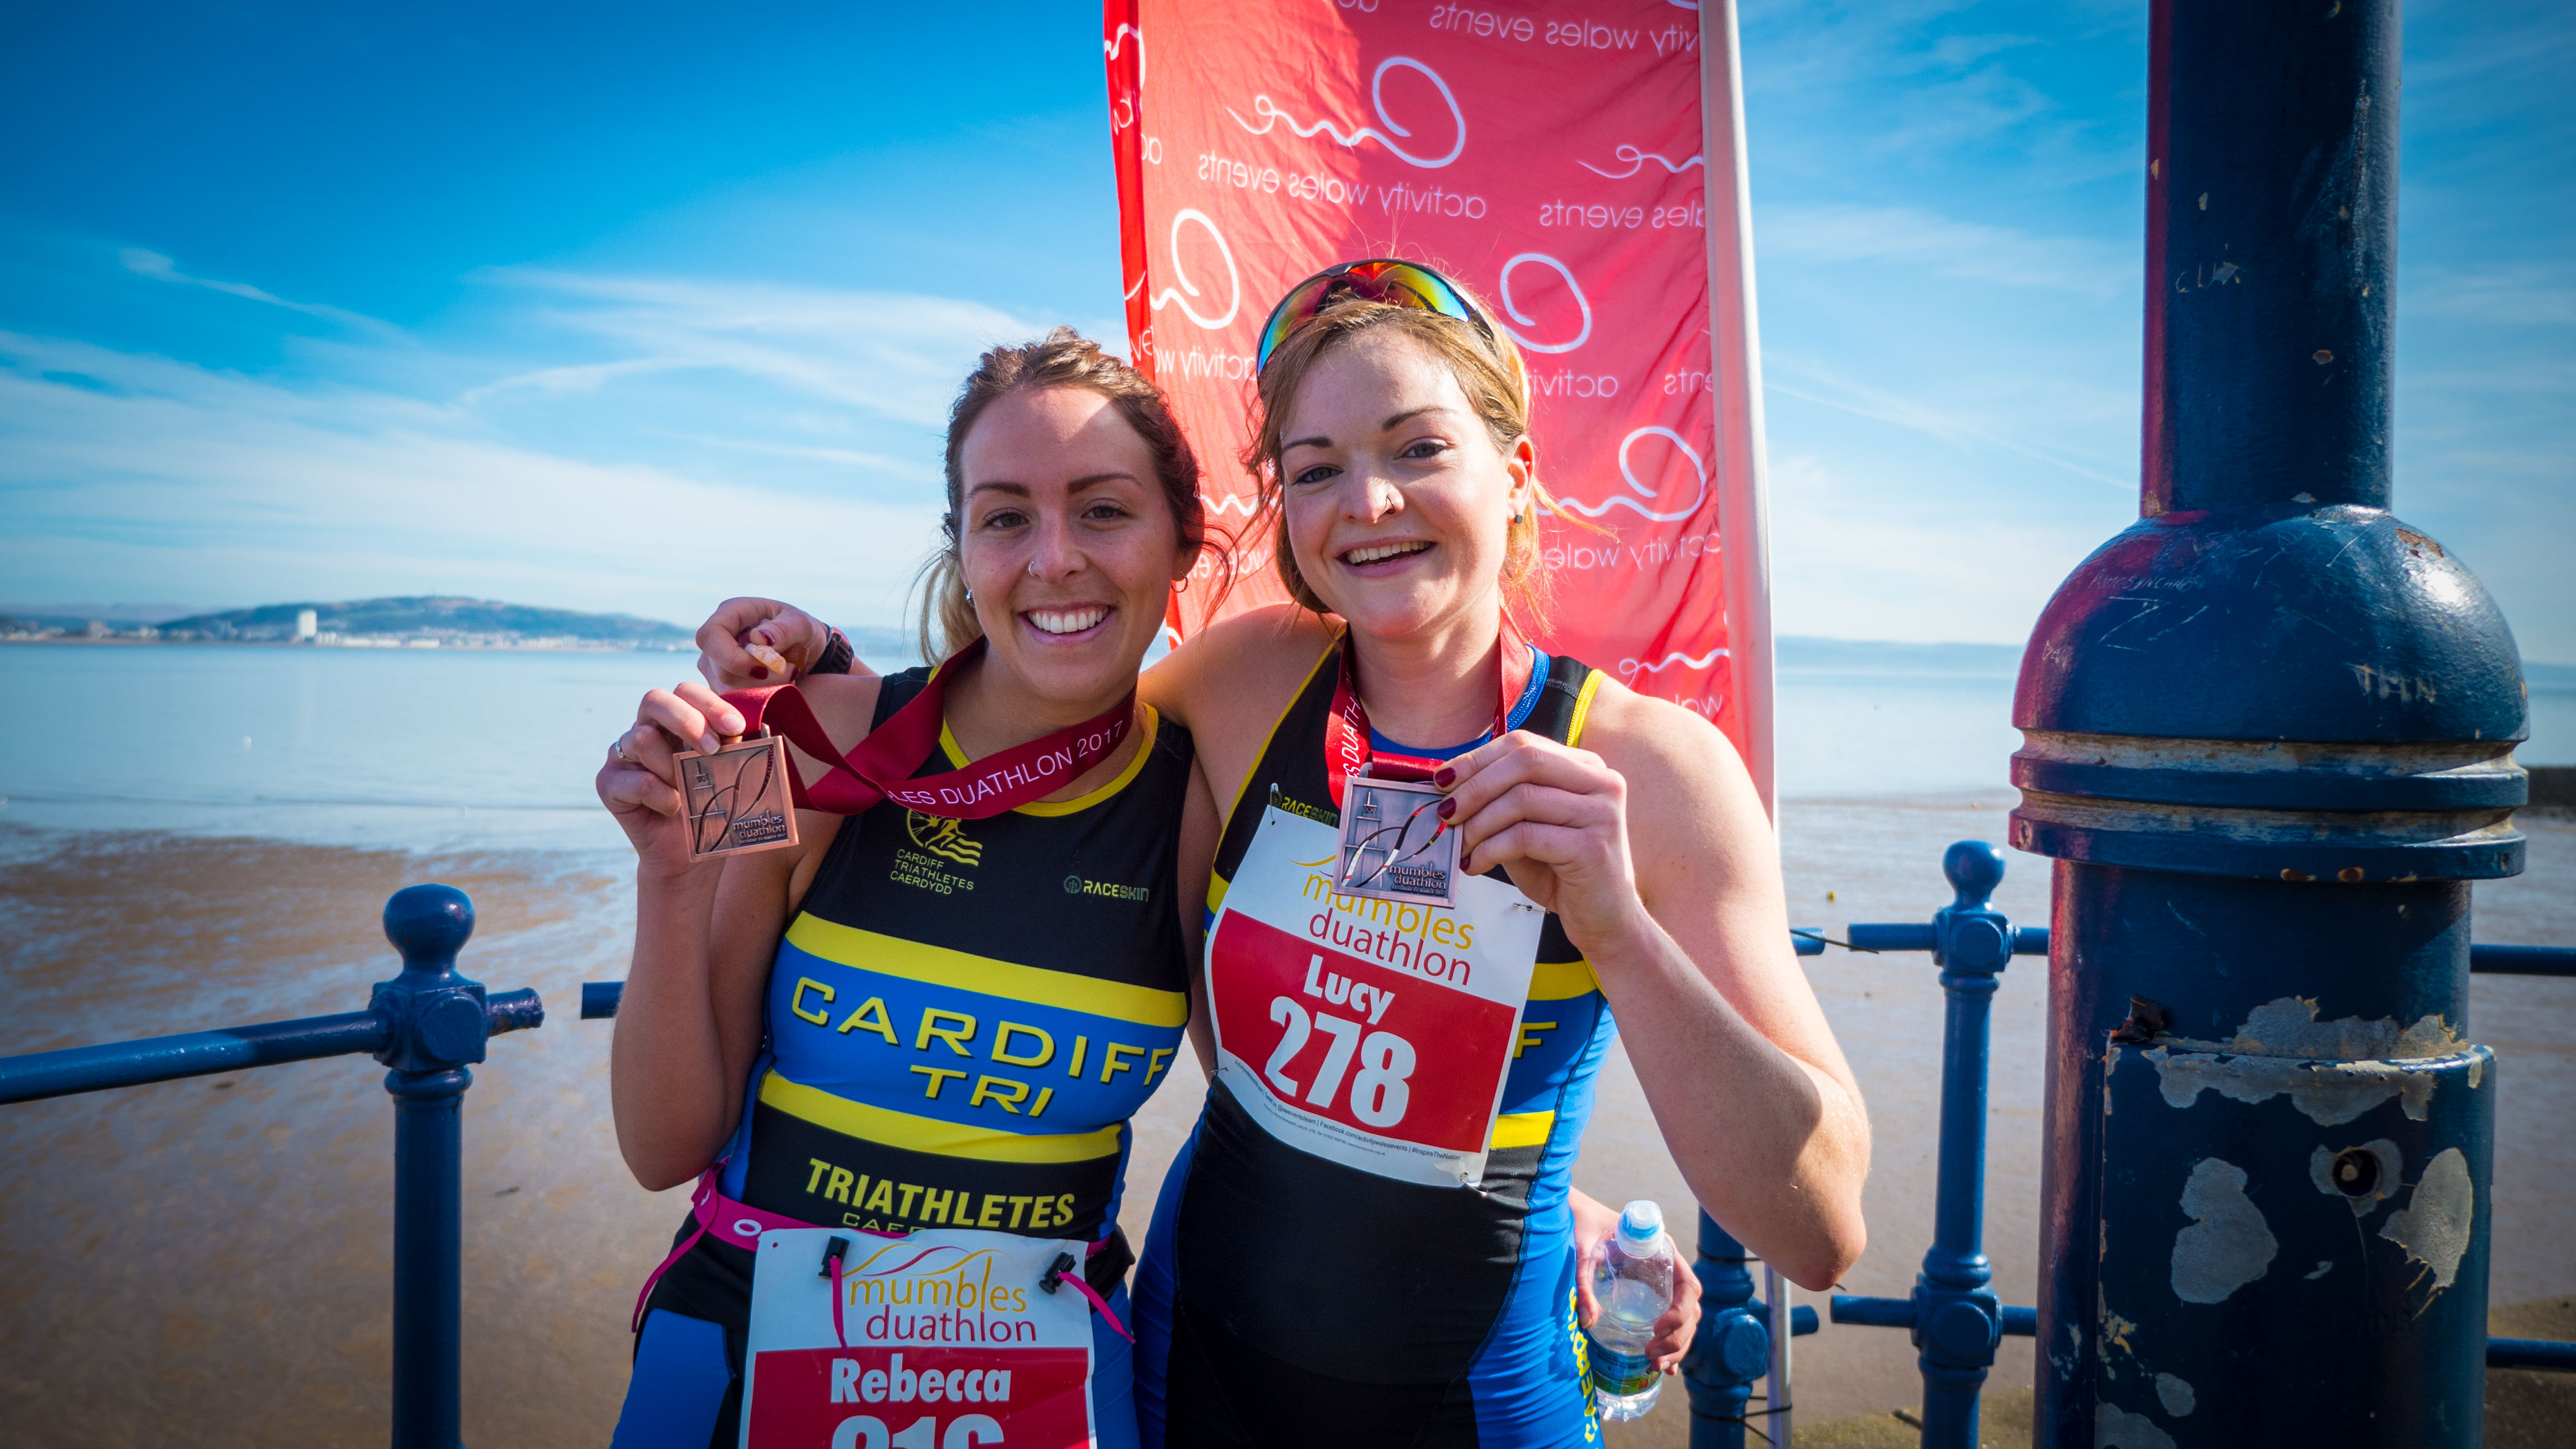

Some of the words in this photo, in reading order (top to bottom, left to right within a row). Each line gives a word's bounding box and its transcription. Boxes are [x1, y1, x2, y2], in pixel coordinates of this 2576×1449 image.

[940, 747, 1073, 805] DUATHLON
[1077, 719, 1124, 759] 2017
[733, 809, 783, 831] mumbles
[740, 825, 785, 839] duathlon
[894, 859, 974, 891] TRIATHLETES
[897, 848, 945, 870] CARDIFF
[1389, 863, 1445, 879] mumbles
[1394, 874, 1447, 889] duathlon
[889, 870, 953, 895] CAERDYDD
[1083, 879, 1150, 902] RACESKIN
[1303, 873, 1475, 950] mumbles
[1309, 907, 1472, 986] duathlon
[1303, 953, 1396, 1025] Lucy
[792, 976, 1174, 1087] CARDIFF
[1263, 995, 1417, 1128] 278
[910, 1064, 1054, 1117] TRI
[1319, 1121, 1408, 1152] Facebook.com/activitywalesevents
[1412, 1147, 1461, 1161] #InspireTheNation
[806, 1157, 1075, 1229] TRIATHLETES
[850, 1255, 1027, 1313] mumbles
[866, 1304, 1037, 1342] duathlon
[830, 1352, 1012, 1404] Rebecca
